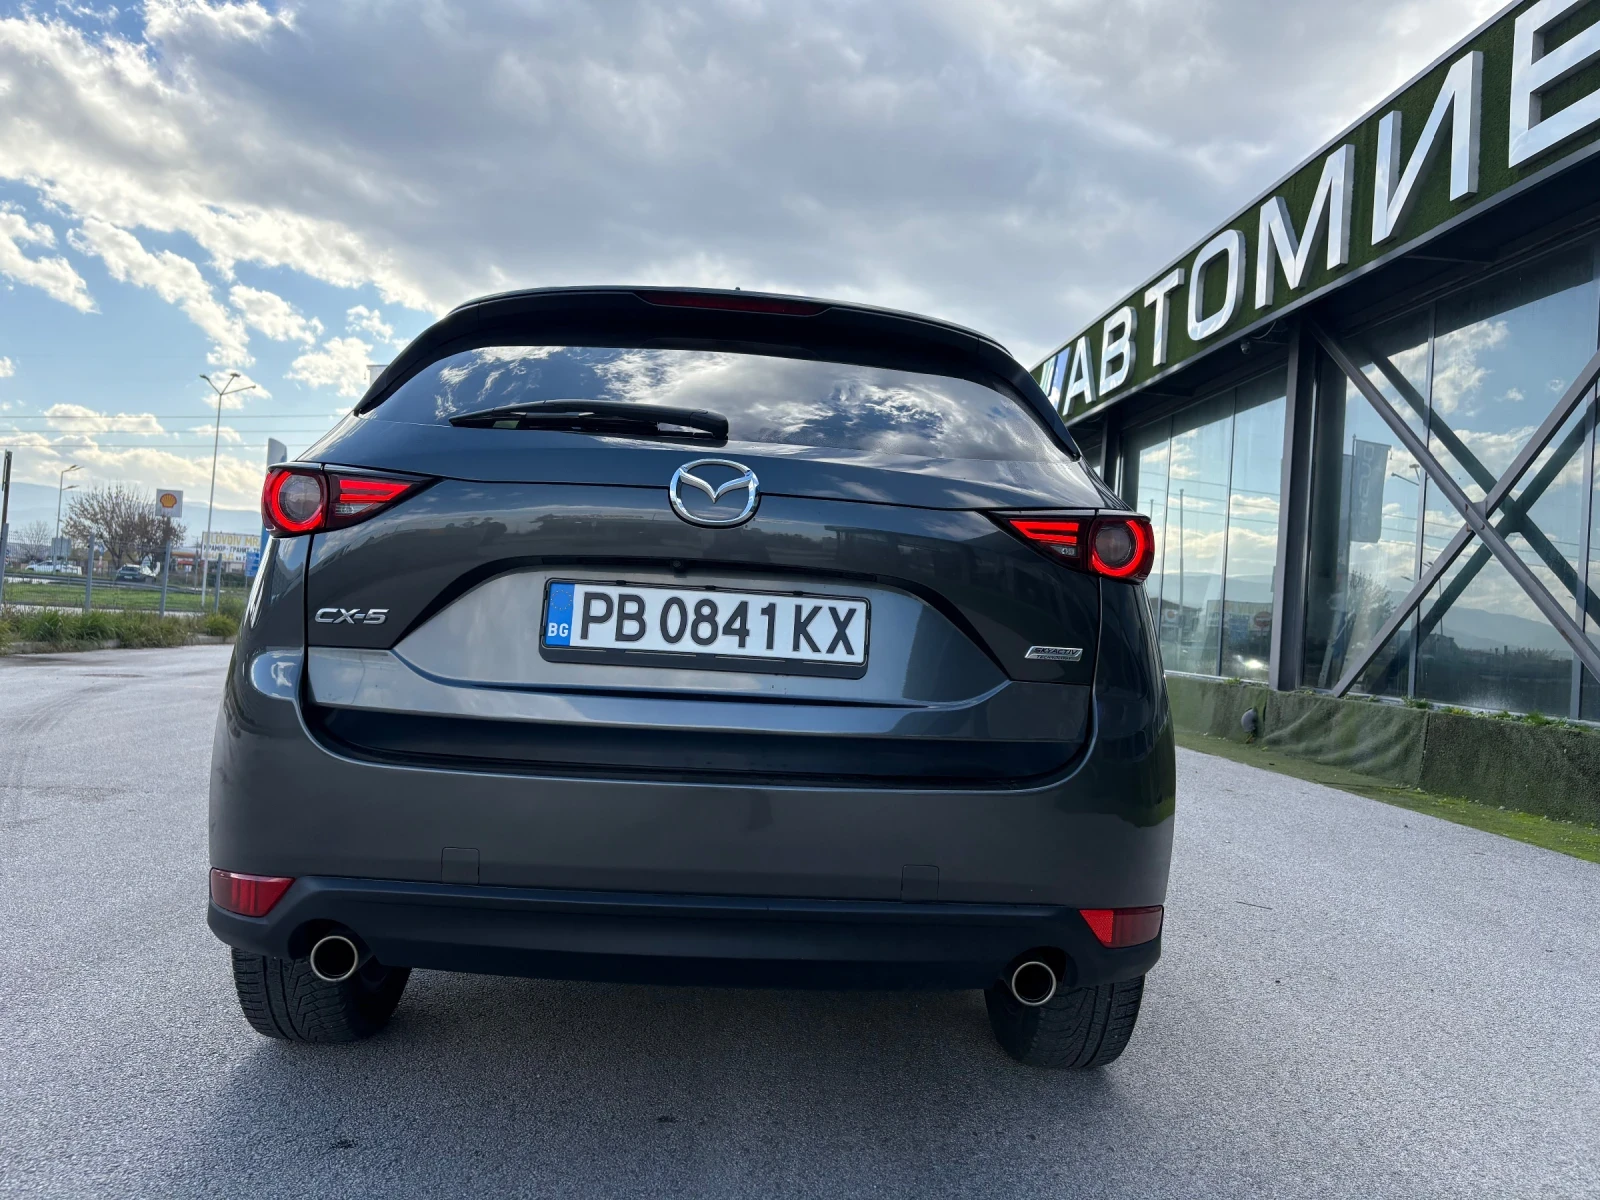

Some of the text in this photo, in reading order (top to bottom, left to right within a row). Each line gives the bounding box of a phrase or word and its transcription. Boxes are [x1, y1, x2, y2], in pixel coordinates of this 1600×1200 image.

[315, 607, 390, 625] CX-5
[580, 591, 858, 656] PB 0841 KX
[547, 622, 569, 638] BG
